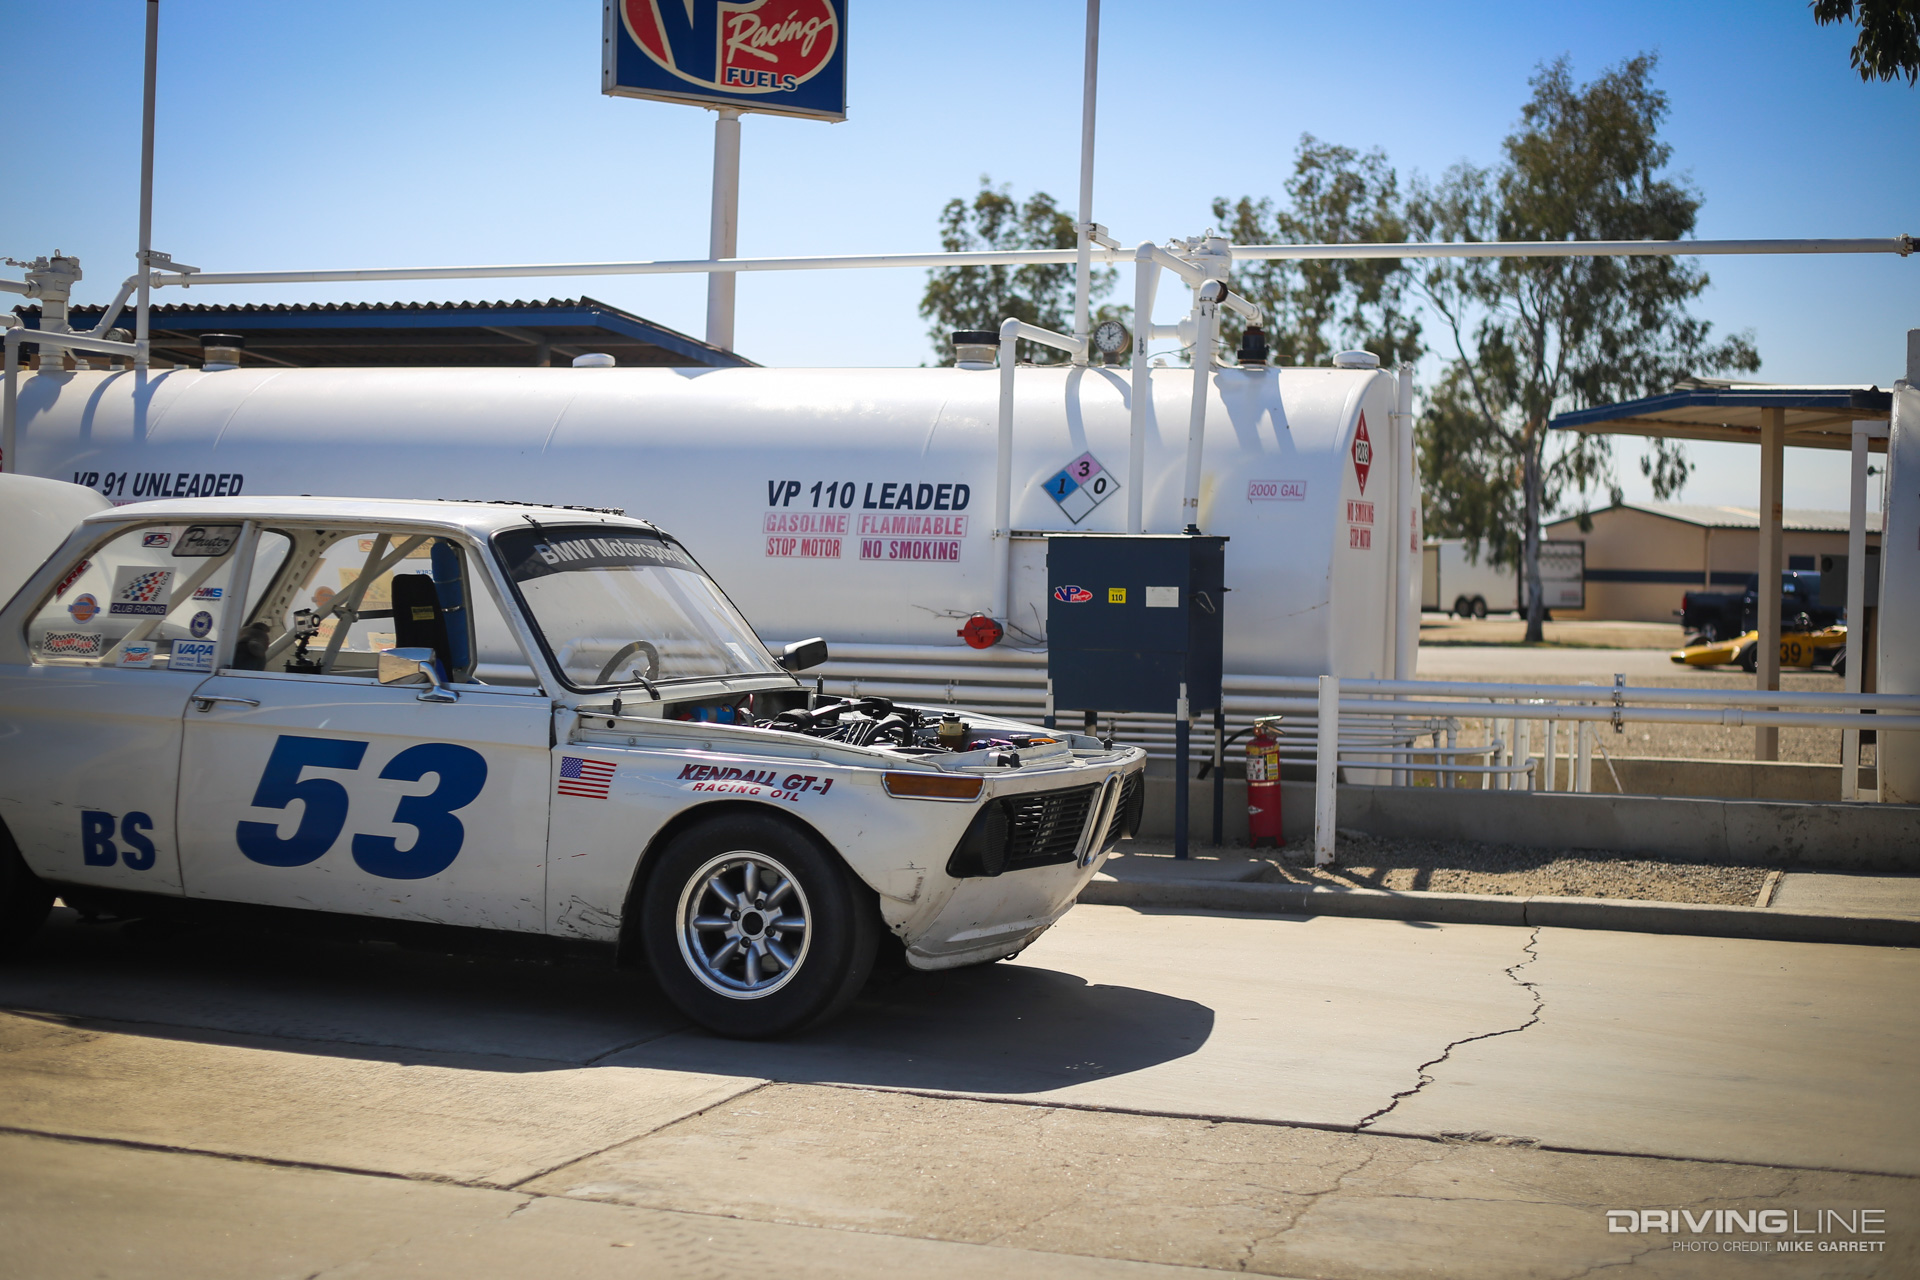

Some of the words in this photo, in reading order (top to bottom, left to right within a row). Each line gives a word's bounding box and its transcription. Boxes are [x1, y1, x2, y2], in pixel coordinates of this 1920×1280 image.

[726, 10, 824, 64] Racing
[726, 67, 798, 92] FUELS
[1356, 442, 1369, 463] 1203
[1078, 461, 1090, 477] 3
[103, 472, 127, 497] 91
[133, 473, 244, 498] UNLEADED
[768, 480, 801, 507] VP
[810, 481, 856, 509] 110
[863, 483, 971, 510] LEADED
[1057, 479, 1066, 494] 1
[1094, 478, 1107, 494] 0
[1251, 484, 1277, 497] 2000
[1347, 502, 1354, 521] NO
[1355, 502, 1374, 523] SMOKING
[766, 514, 847, 533] GASOLINE
[861, 516, 963, 535] FLAMMABLE
[1350, 528, 1359, 548] STOP
[534, 538, 593, 565] BMW
[592, 537, 686, 565] Motorsports
[767, 538, 796, 556] STOP
[801, 539, 840, 557] MOTOR
[862, 540, 882, 559] NO
[889, 541, 958, 560] SMOKING
[57, 560, 88, 596] ARP
[161, 571, 171, 586] CCA
[193, 587, 223, 598] HMS
[1057, 586, 1081, 602] VP
[1111, 593, 1123, 602] 110
[111, 604, 133, 613] CLUB
[134, 605, 166, 614] RACING
[52, 638, 75, 648] VICTORY
[77, 641, 93, 649] LANE
[1779, 642, 1801, 664] 39
[677, 763, 776, 788] KENDALL
[782, 774, 833, 796] GT-1
[692, 782, 760, 796] RACING
[770, 789, 799, 802] OIL
[236, 734, 488, 880] 53
[81, 810, 156, 871] BS
